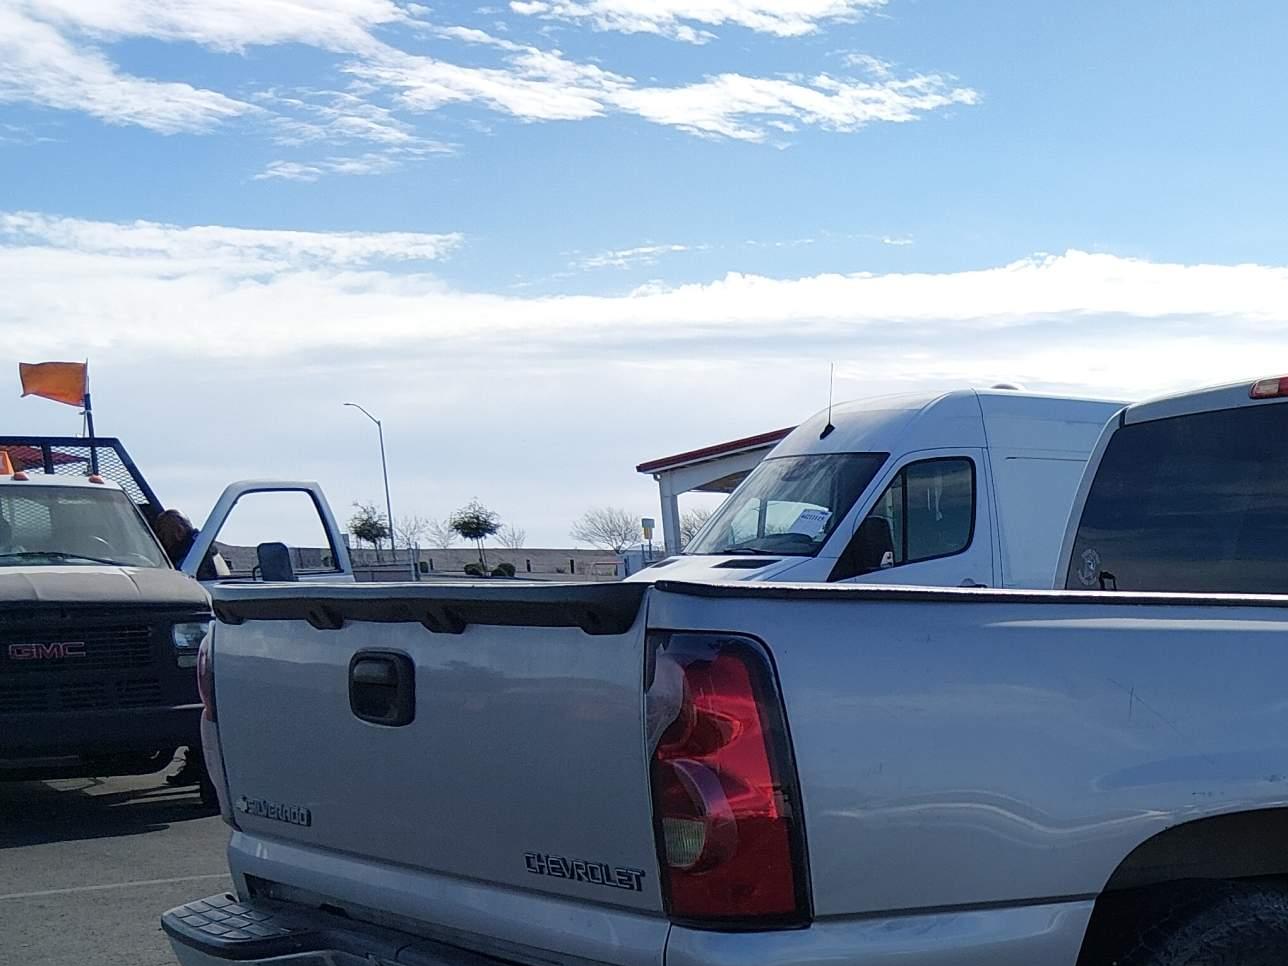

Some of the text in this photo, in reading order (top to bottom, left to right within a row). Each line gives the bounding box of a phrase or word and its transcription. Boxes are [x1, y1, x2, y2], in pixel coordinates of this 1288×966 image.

[8, 641, 87, 660] GMC
[246, 798, 312, 828] SILVERADO
[524, 852, 646, 892] CHEVROLET
